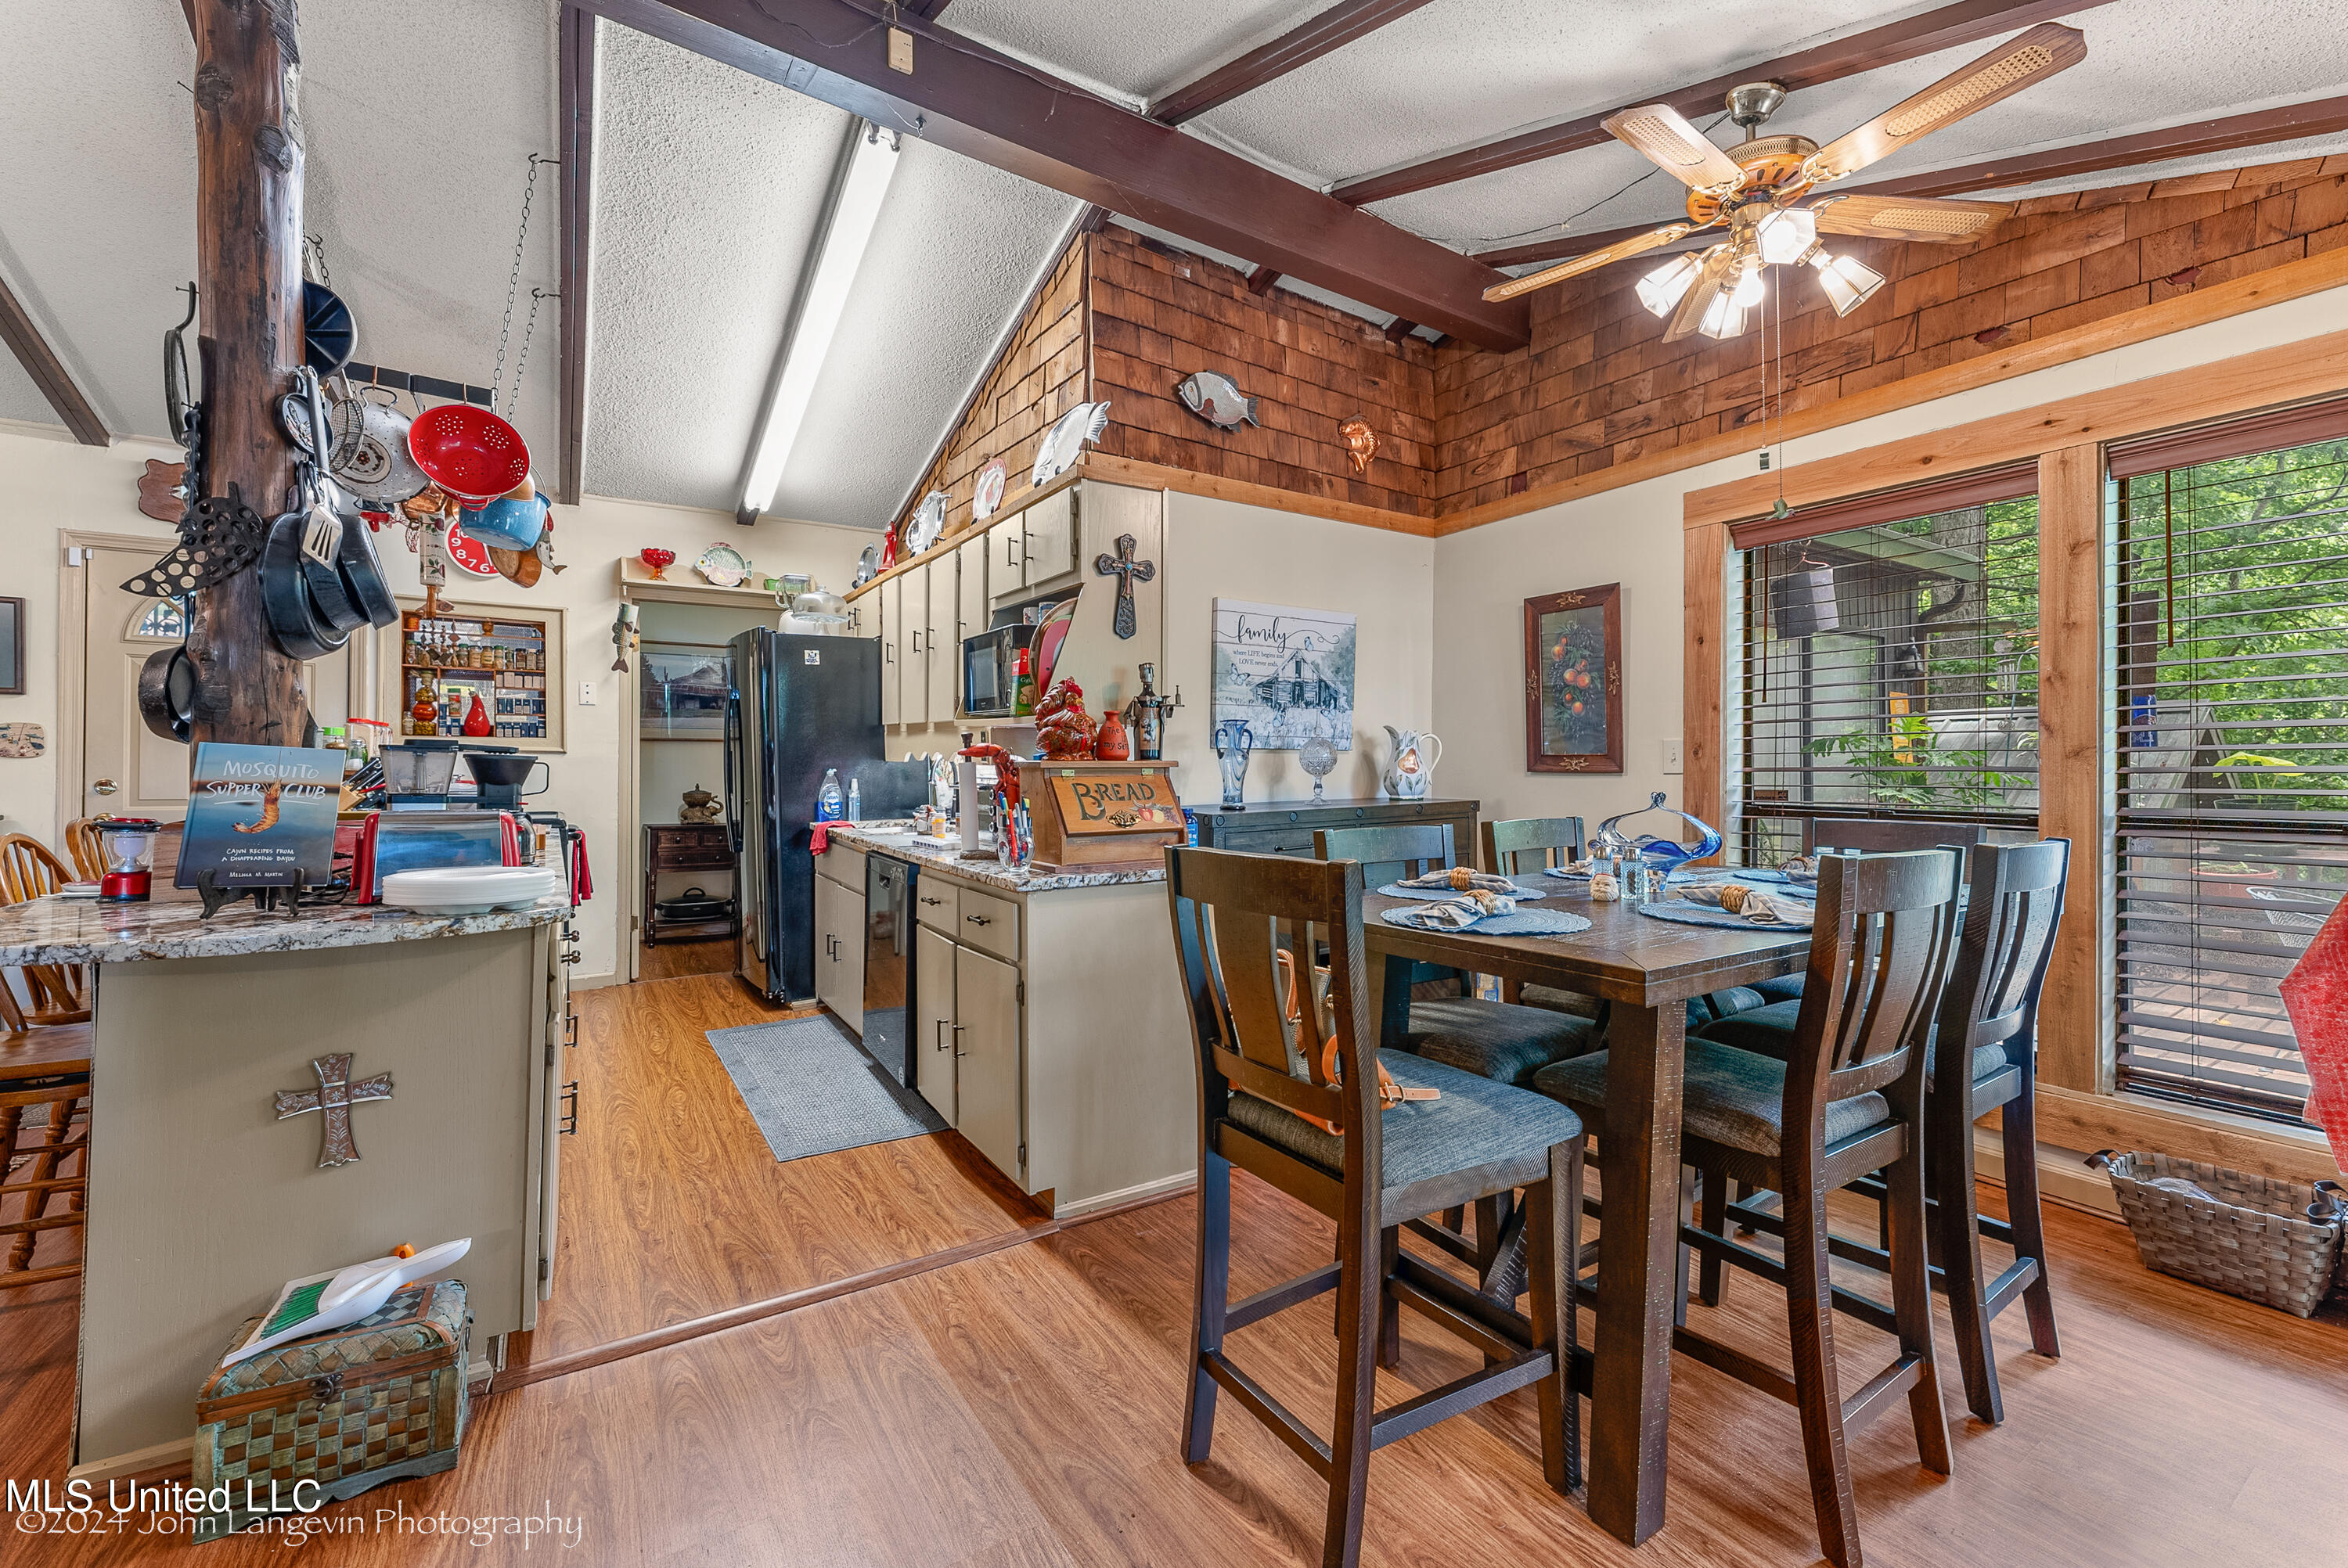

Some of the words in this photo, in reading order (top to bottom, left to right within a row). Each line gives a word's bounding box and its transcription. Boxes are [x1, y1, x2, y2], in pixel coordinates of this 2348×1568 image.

[451, 538, 462, 547] 9
[456, 549, 466, 559] 8
[467, 558, 477, 567] 7
[480, 563, 490, 573] 6
[1237, 614, 1286, 653] family
[1107, 726, 1120, 735] The
[1104, 742, 1115, 751] my
[223, 761, 319, 779] MOSQUITO
[203, 781, 264, 799] SUPPER
[283, 782, 326, 800] CLUB
[1071, 782, 1155, 821] BREAD
